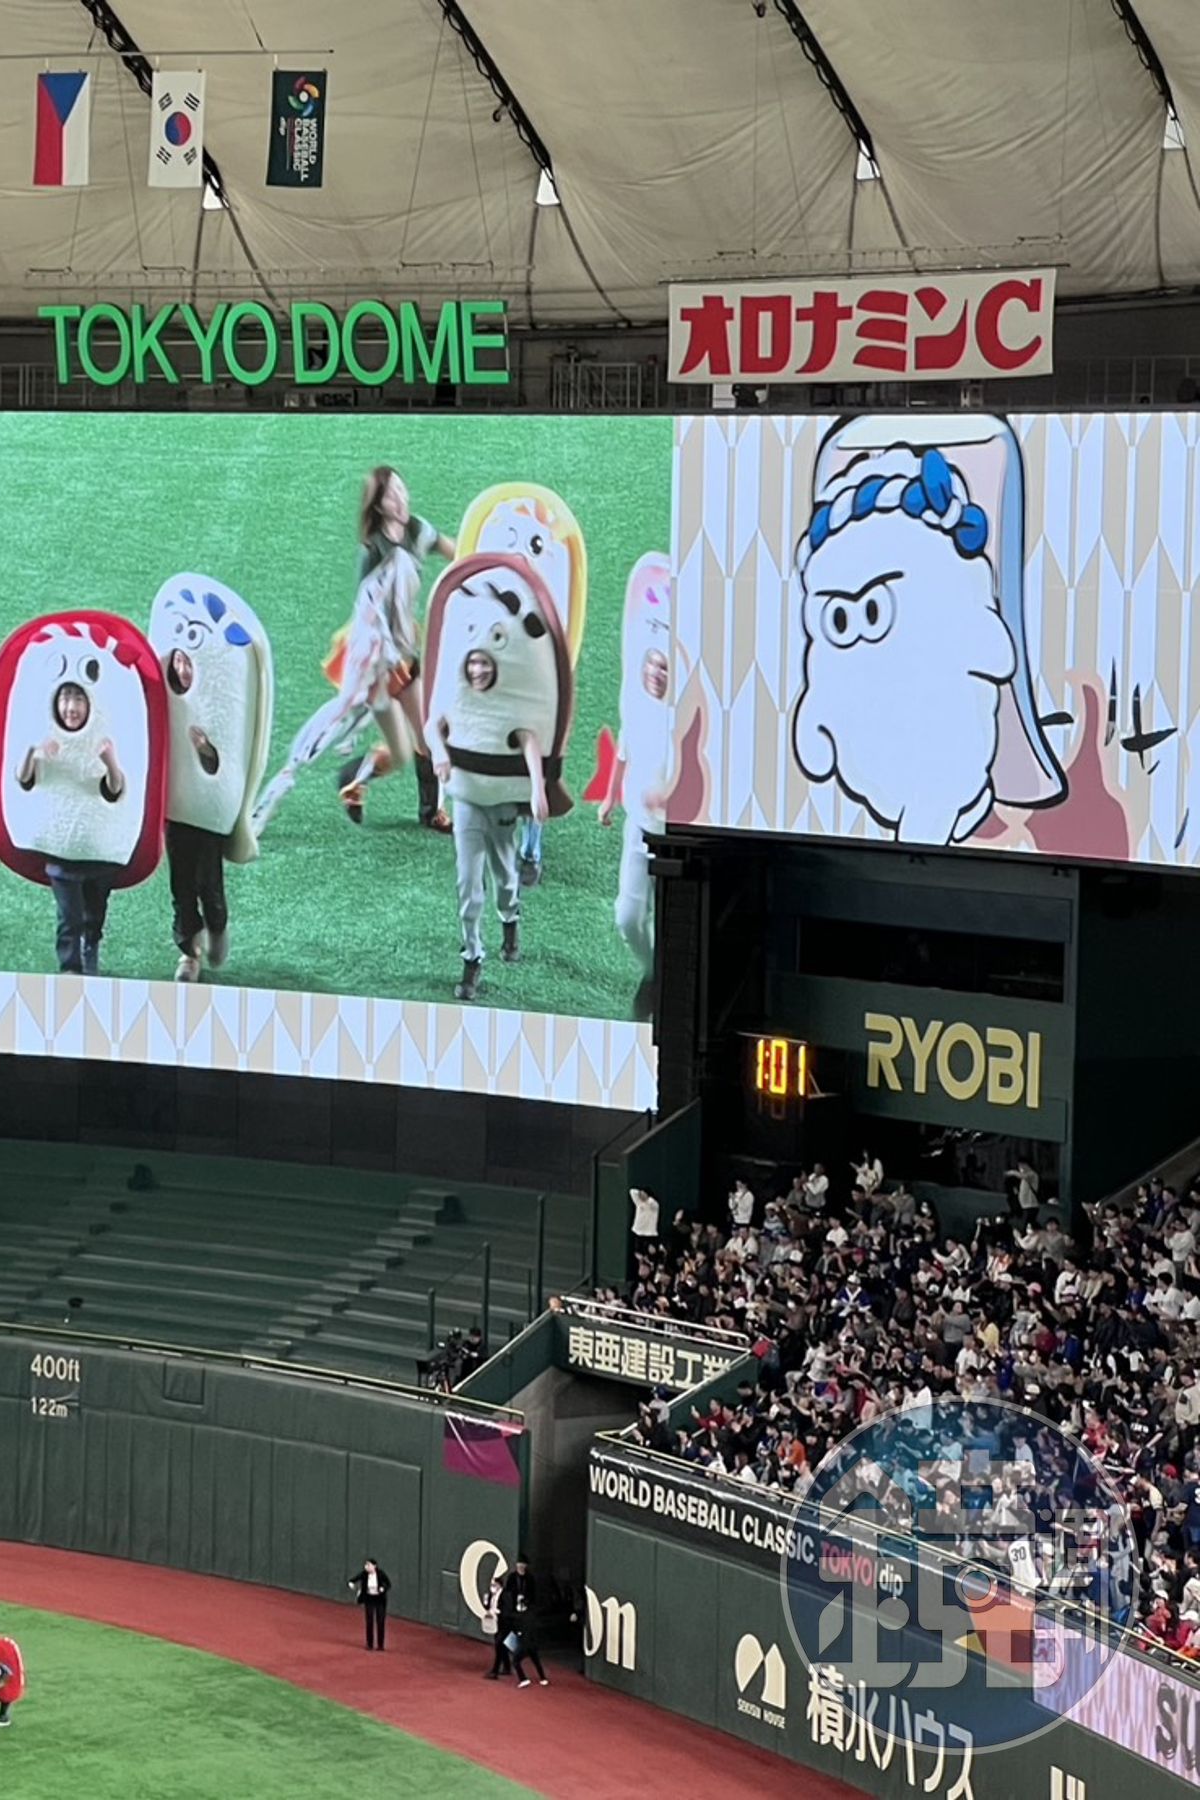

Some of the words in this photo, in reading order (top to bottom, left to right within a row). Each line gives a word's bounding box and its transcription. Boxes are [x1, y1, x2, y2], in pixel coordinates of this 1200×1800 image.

[38, 302, 277, 385] TOKYO
[291, 300, 510, 384] DOME
[679, 278, 1043, 375] オロナミンC
[865, 1012, 1040, 1109] RYOBI
[30, 1353, 80, 1382] 400ft
[31, 1396, 68, 1418] 122m
[589, 1464, 650, 1509] WORLD
[653, 1485, 740, 1539] BASEBALL
[820, 1540, 874, 1587] TOKYO
[878, 1565, 904, 1600] dip
[1010, 1546, 1027, 1562] 30
[806, 1661, 975, 1800] 積水ハウス
